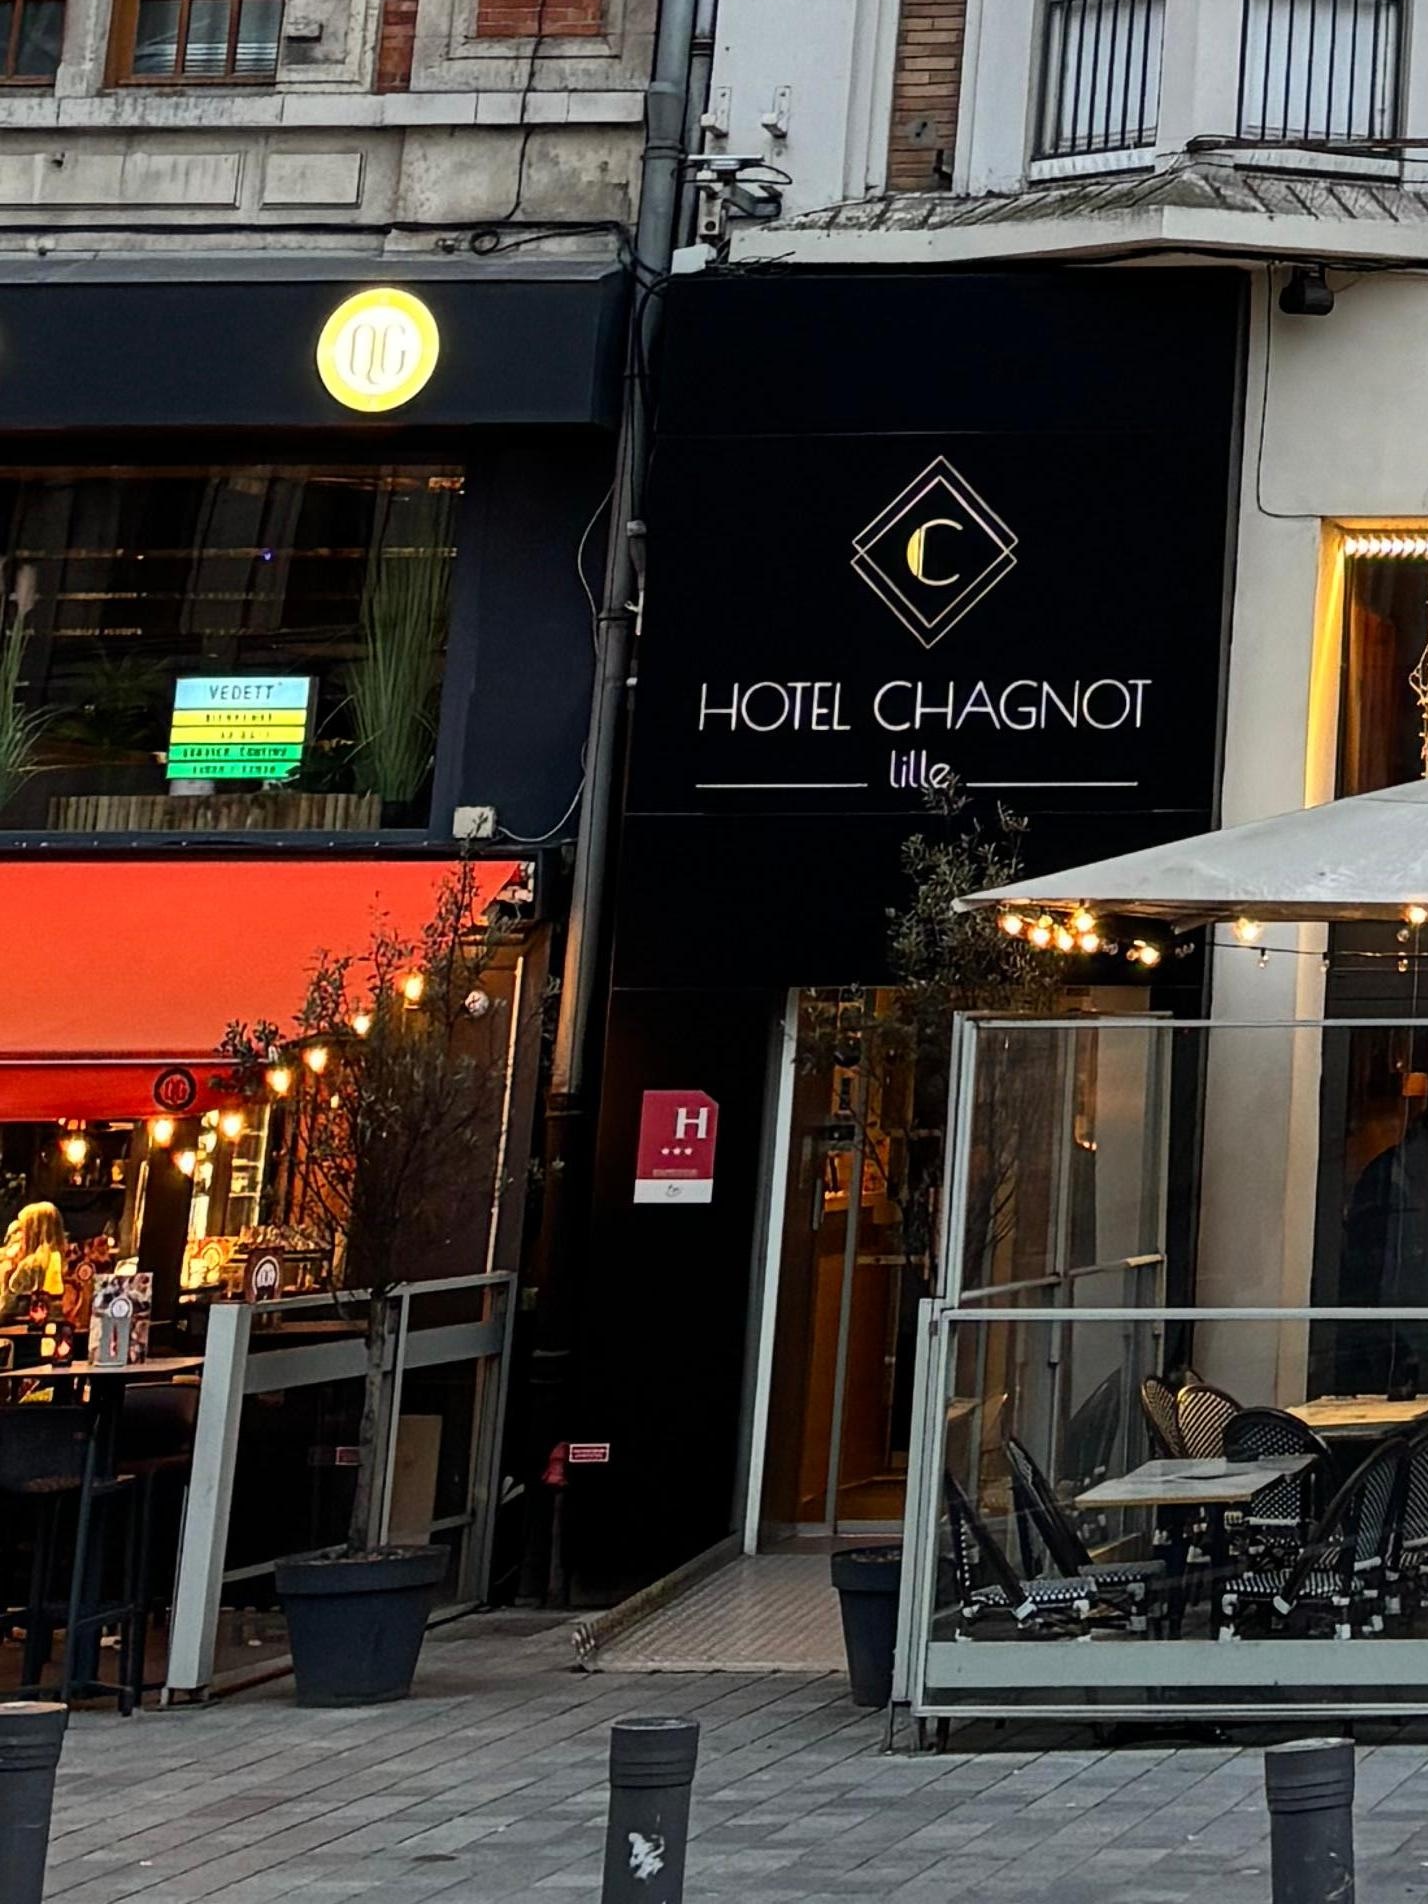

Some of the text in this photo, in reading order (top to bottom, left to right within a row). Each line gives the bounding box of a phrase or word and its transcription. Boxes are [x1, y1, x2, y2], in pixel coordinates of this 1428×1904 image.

[349, 322, 407, 386] QG
[208, 684, 276, 700] VEDETT
[698, 678, 1153, 732] HOTEL CHAGNOT
[889, 748, 952, 789] lille
[674, 1105, 709, 1140] H
